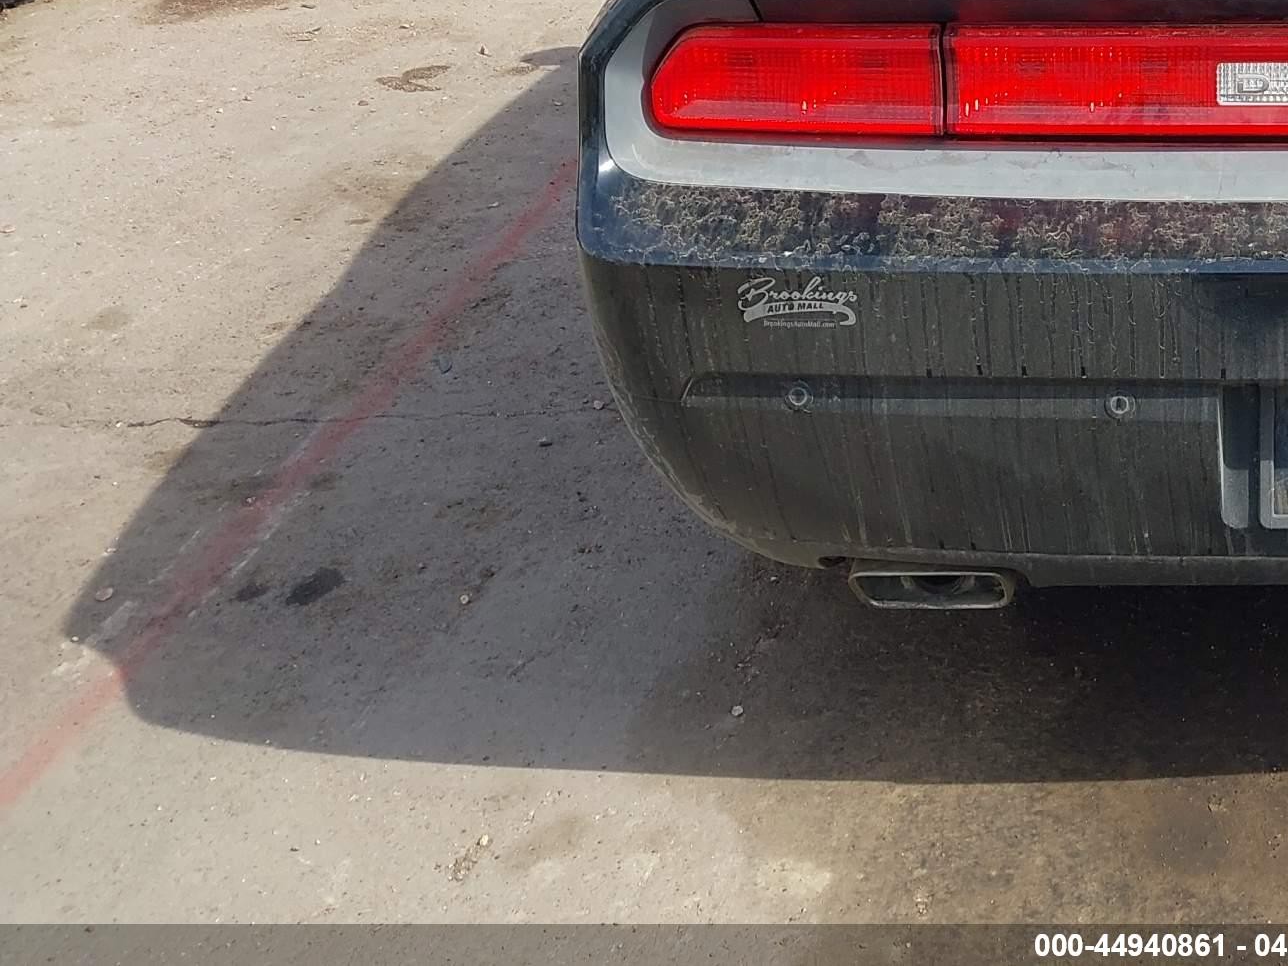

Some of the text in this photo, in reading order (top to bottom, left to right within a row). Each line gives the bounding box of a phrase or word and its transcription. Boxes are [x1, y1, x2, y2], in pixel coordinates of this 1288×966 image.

[737, 276, 858, 311] Brookings
[767, 301, 824, 313] AUTO MALL
